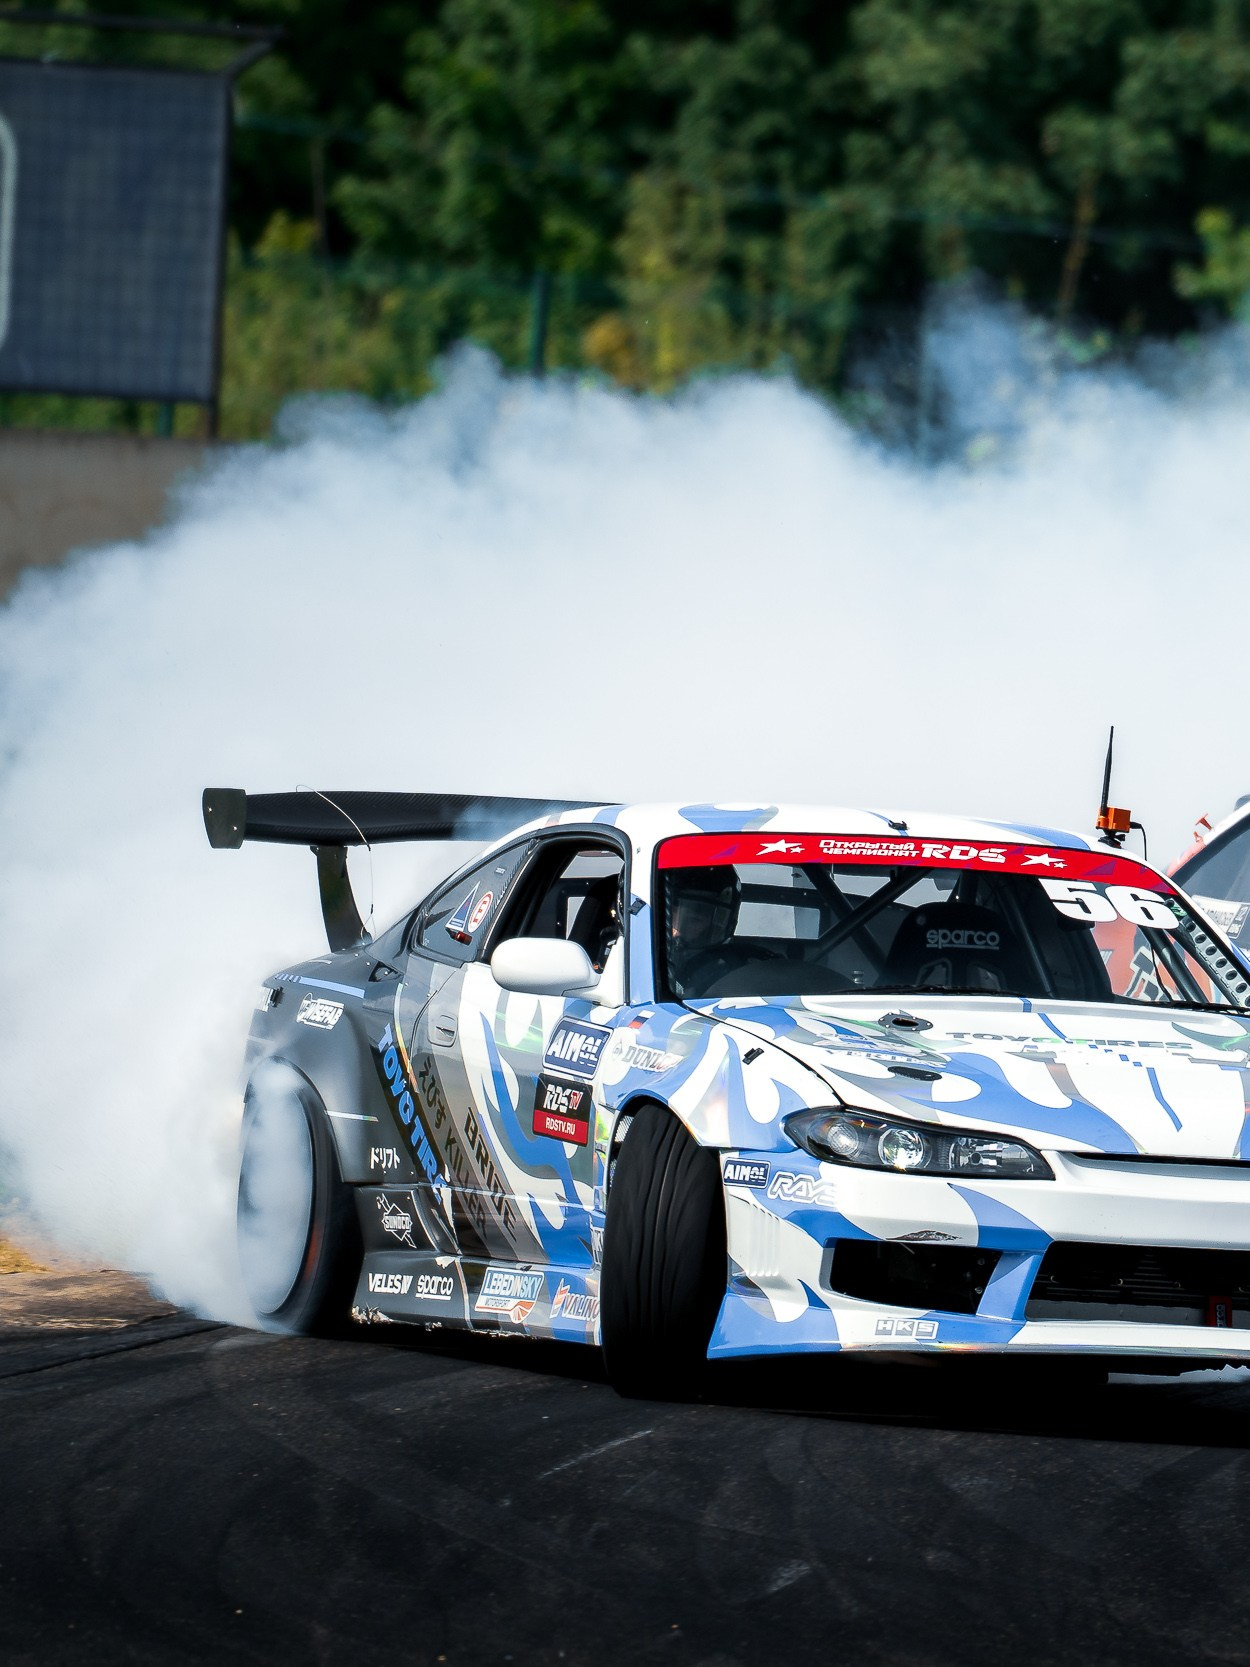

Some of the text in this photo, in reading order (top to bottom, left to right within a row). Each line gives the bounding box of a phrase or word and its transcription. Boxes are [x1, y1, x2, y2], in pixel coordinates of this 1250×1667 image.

[921, 843, 1007, 863] RDS
[1038, 878, 1179, 929] 56
[926, 929, 1000, 949] sparco
[547, 1029, 602, 1067] AIMOL
[622, 1045, 681, 1072] DUNL
[545, 1117, 576, 1136] RDSTV.RU
[370, 1147, 400, 1169] ドリフト
[724, 1164, 766, 1183] AIMOL
[384, 1215, 411, 1230] SUNOCO
[416, 1274, 453, 1300] sparco
[483, 1272, 542, 1299] LEBEDINSKY
[876, 1319, 935, 1335] HKS
